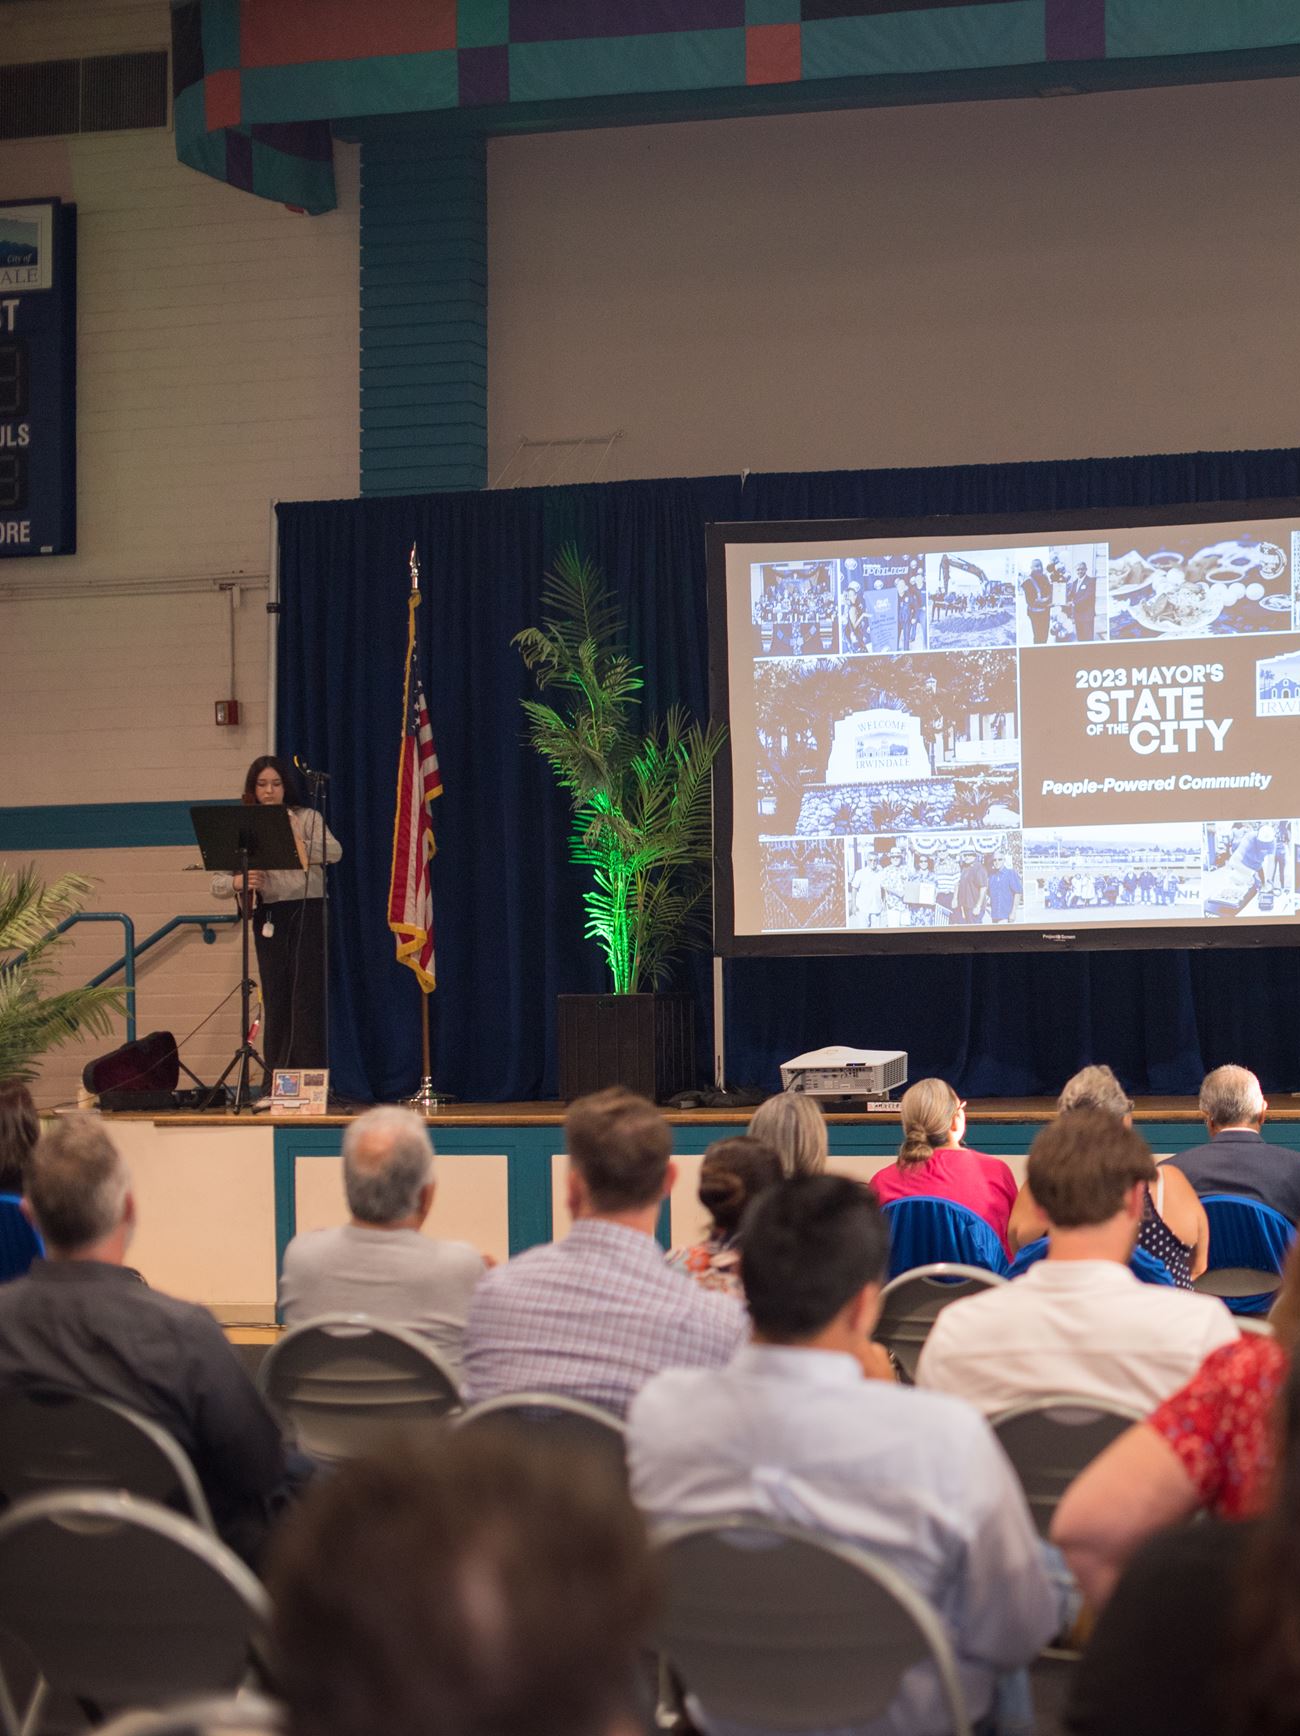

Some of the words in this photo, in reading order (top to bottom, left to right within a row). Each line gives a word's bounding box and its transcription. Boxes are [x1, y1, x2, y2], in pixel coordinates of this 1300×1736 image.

[1075, 668, 1127, 688] 2023
[1131, 663, 1224, 686] MAYOR'S
[1086, 686, 1204, 723] STATE
[1086, 724, 1104, 736] OF
[1105, 722, 1129, 735] THE
[1129, 718, 1233, 755] CITY
[1041, 775, 1177, 797] People-Powered
[1178, 771, 1273, 790] Community
